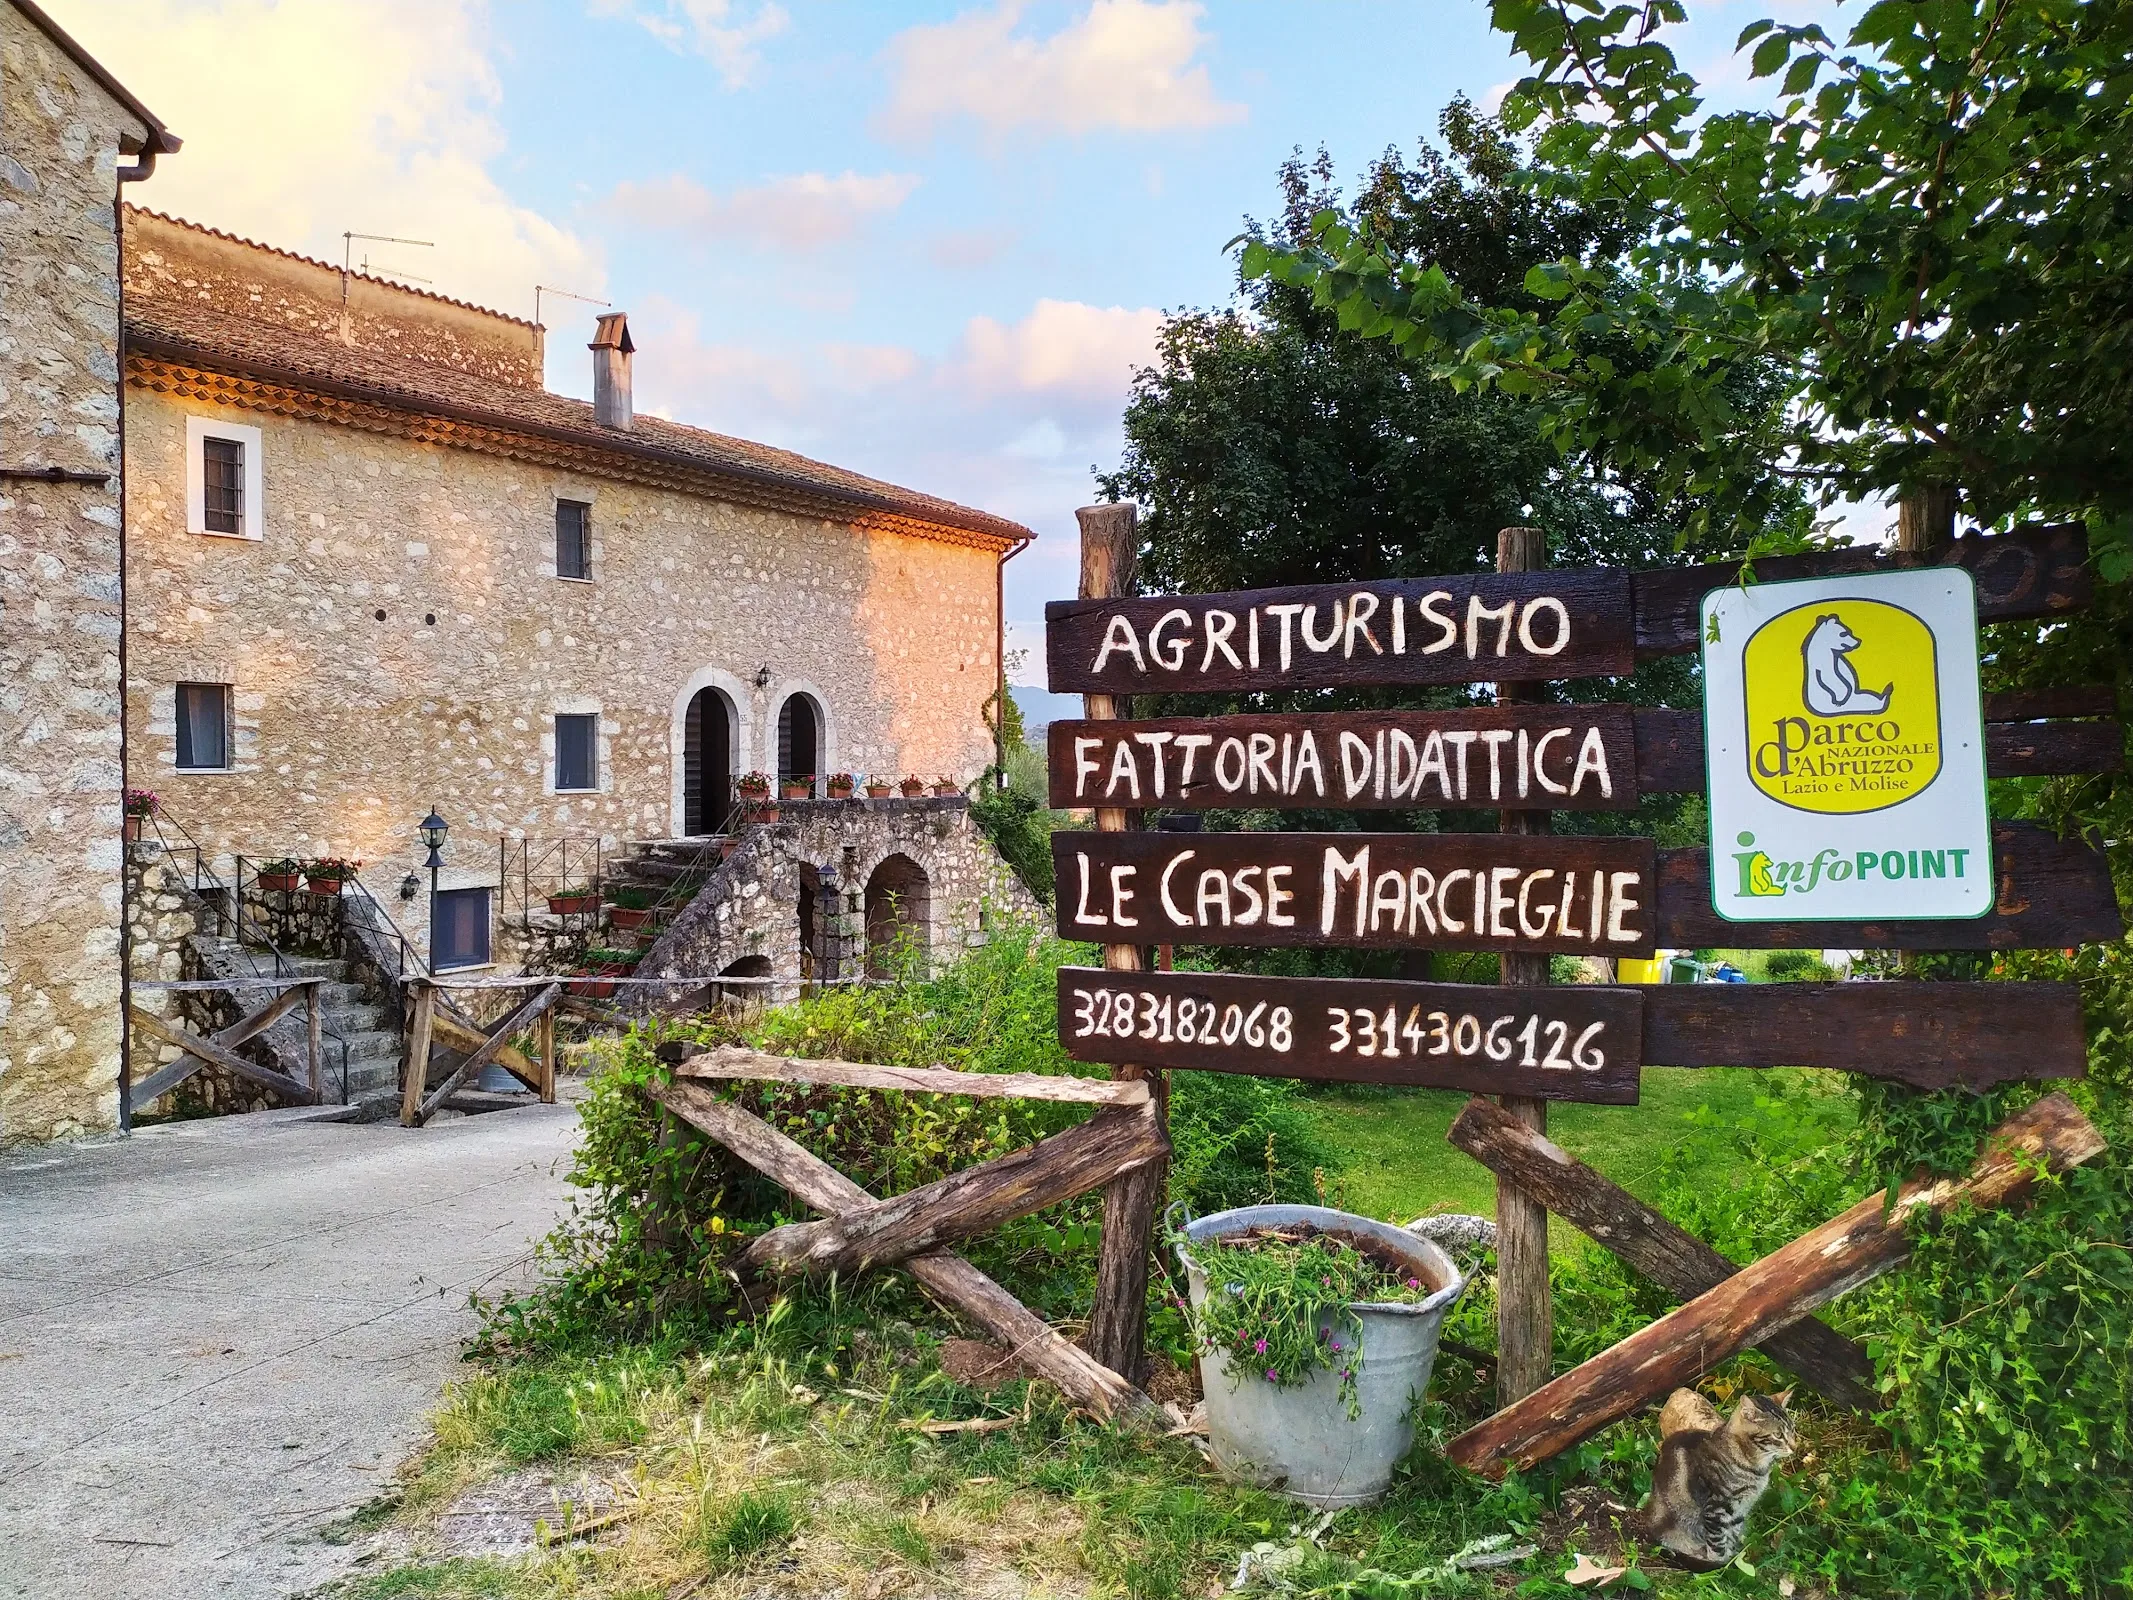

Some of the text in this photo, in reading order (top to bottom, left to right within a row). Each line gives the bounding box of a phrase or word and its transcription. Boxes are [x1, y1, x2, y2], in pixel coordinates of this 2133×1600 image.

[1091, 590, 1570, 674] AGRITURISMO
[1074, 725, 1613, 801] FATTORIA DIDATTICA
[1782, 775, 1909, 795] Lazio e Molise
[1827, 743, 1935, 759] NAZIONALE
[1074, 843, 1642, 943] LE CASE MARCIEGLIE
[1073, 987, 1607, 1072] 3283182068 3314306126
